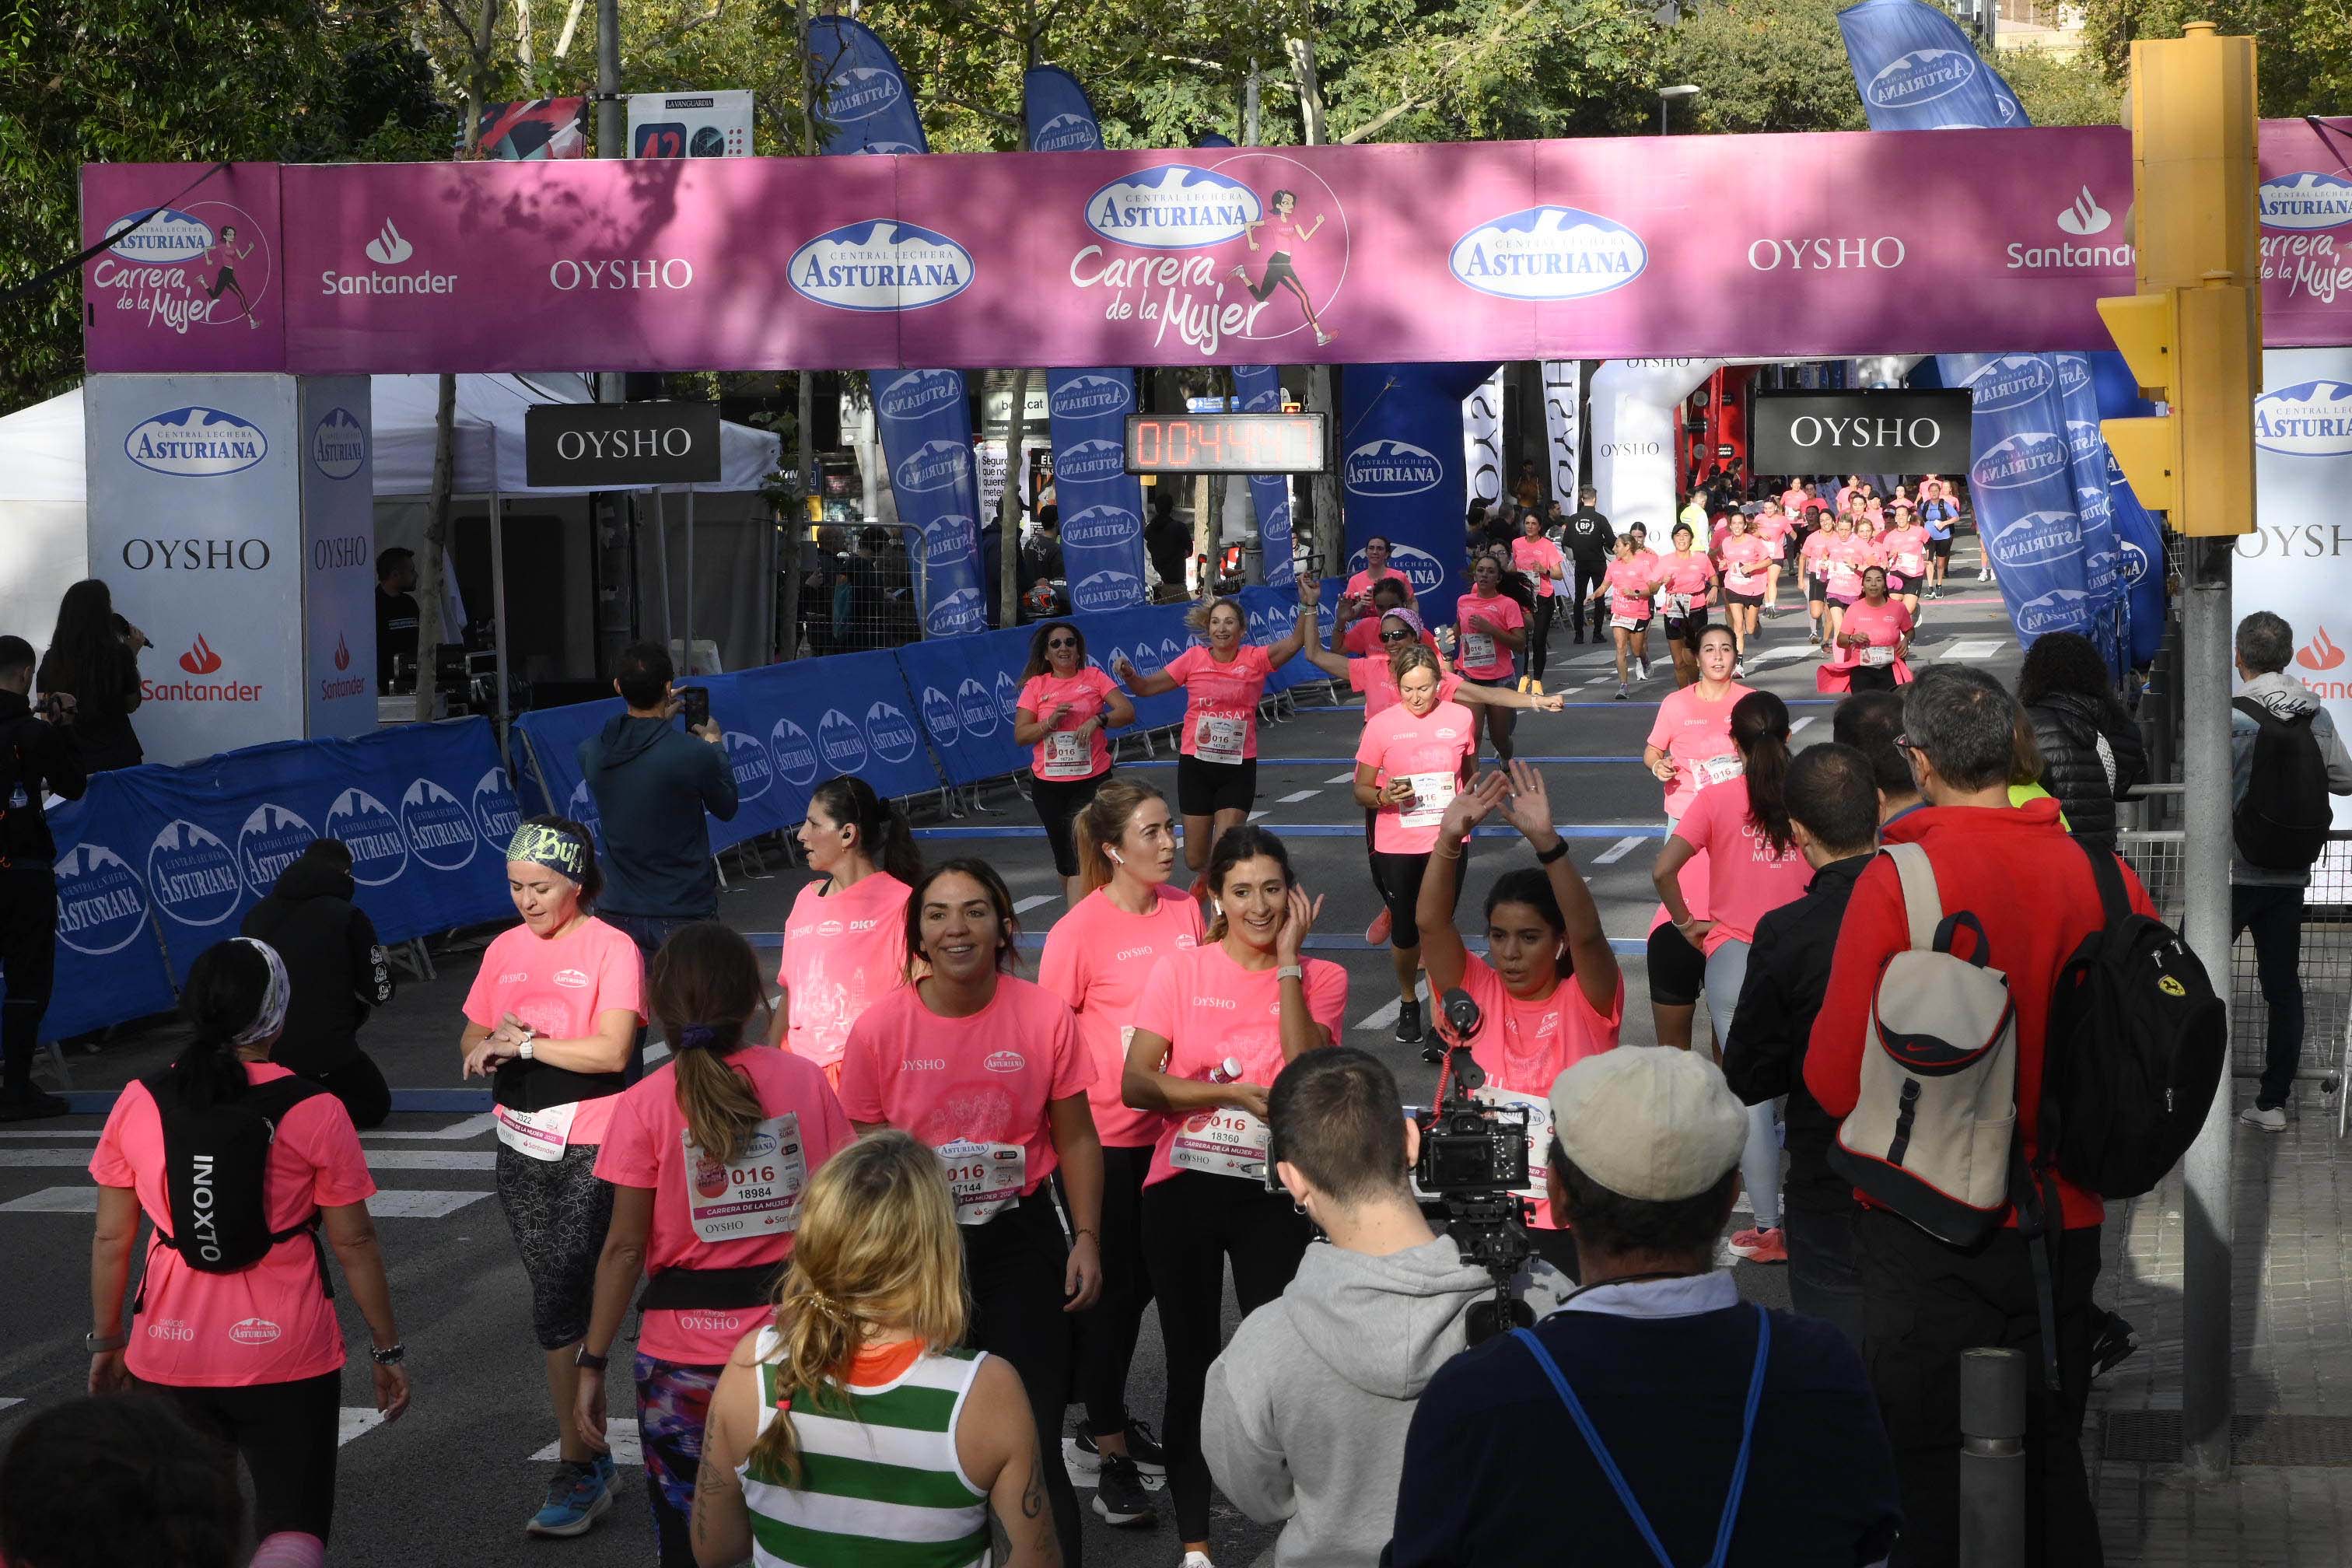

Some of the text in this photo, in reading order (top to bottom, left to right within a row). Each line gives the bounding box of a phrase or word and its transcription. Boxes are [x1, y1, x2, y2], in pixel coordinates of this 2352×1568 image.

[1125, 193, 1243, 203] CENTRAL LECHERA
[1098, 196, 1248, 228] ASTURIANA
[830, 250, 954, 260] CENTRAL LECHERA
[1748, 236, 1906, 271] OYSHO
[2006, 242, 2137, 268] Santand
[2259, 234, 2334, 257] arrera
[1069, 245, 1215, 289] Carrera
[1464, 242, 1632, 277] ASTURIANA
[93, 260, 186, 288] Carrera
[321, 270, 458, 296] Santander
[549, 259, 694, 291] OYSHO
[801, 254, 961, 289] ASTURIANA
[2278, 258, 2291, 279] la
[2289, 254, 2352, 304] Muje
[117, 286, 221, 334] de la Mujer
[1105, 284, 1269, 355] de la Mujer
[557, 427, 692, 460] OYSHO
[1790, 415, 1941, 449] OYSHO
[135, 432, 258, 460] ASTURIANA
[317, 435, 362, 462] ASTURIANA
[1600, 441, 1661, 458] OYSHO
[982, 455, 1007, 467] Segur
[983, 468, 996, 479] que
[1346, 462, 1436, 485] ASTURIANA
[122, 537, 271, 570] OYSHO
[314, 536, 367, 570] OYSHO
[141, 679, 263, 702] Santander
[322, 676, 366, 701] Santander
[1199, 697, 1213, 708] TU
[1212, 734, 1230, 744] 016
[778, 747, 816, 772] ASTURIANA
[1713, 768, 1731, 780] 016
[408, 814, 474, 851] ASTURIANA
[333, 828, 405, 863] STURIANA
[156, 864, 238, 905] ASTURIANA
[57, 886, 142, 933] ASTURIANA
[849, 919, 878, 930] DKV
[1118, 945, 1153, 961] OYSHO
[1192, 996, 1236, 1010] OYSHO
[987, 1059, 1024, 1068] ASTURIANA
[1210, 1115, 1246, 1132] 016
[1183, 1140, 1210, 1150] CARRERA
[1230, 1148, 1253, 1157] MUJER
[1211, 1132, 1240, 1143] 18360
[941, 1145, 985, 1154] ASTURIANA
[1179, 1152, 1210, 1165] OYSHO
[731, 1165, 775, 1185] 016
[947, 1164, 985, 1181] 016
[738, 1187, 772, 1199] 18984
[975, 1193, 998, 1202] MUJER
[193, 1154, 222, 1262] INOXTO
[706, 1206, 742, 1216] CARRERA
[765, 1199, 789, 1208] MUJER
[705, 1220, 744, 1234] OYSHO
[148, 1324, 194, 1342] OYSHO
[234, 1328, 278, 1339] ASTURIANA
[681, 1317, 739, 1331] OYSHO
